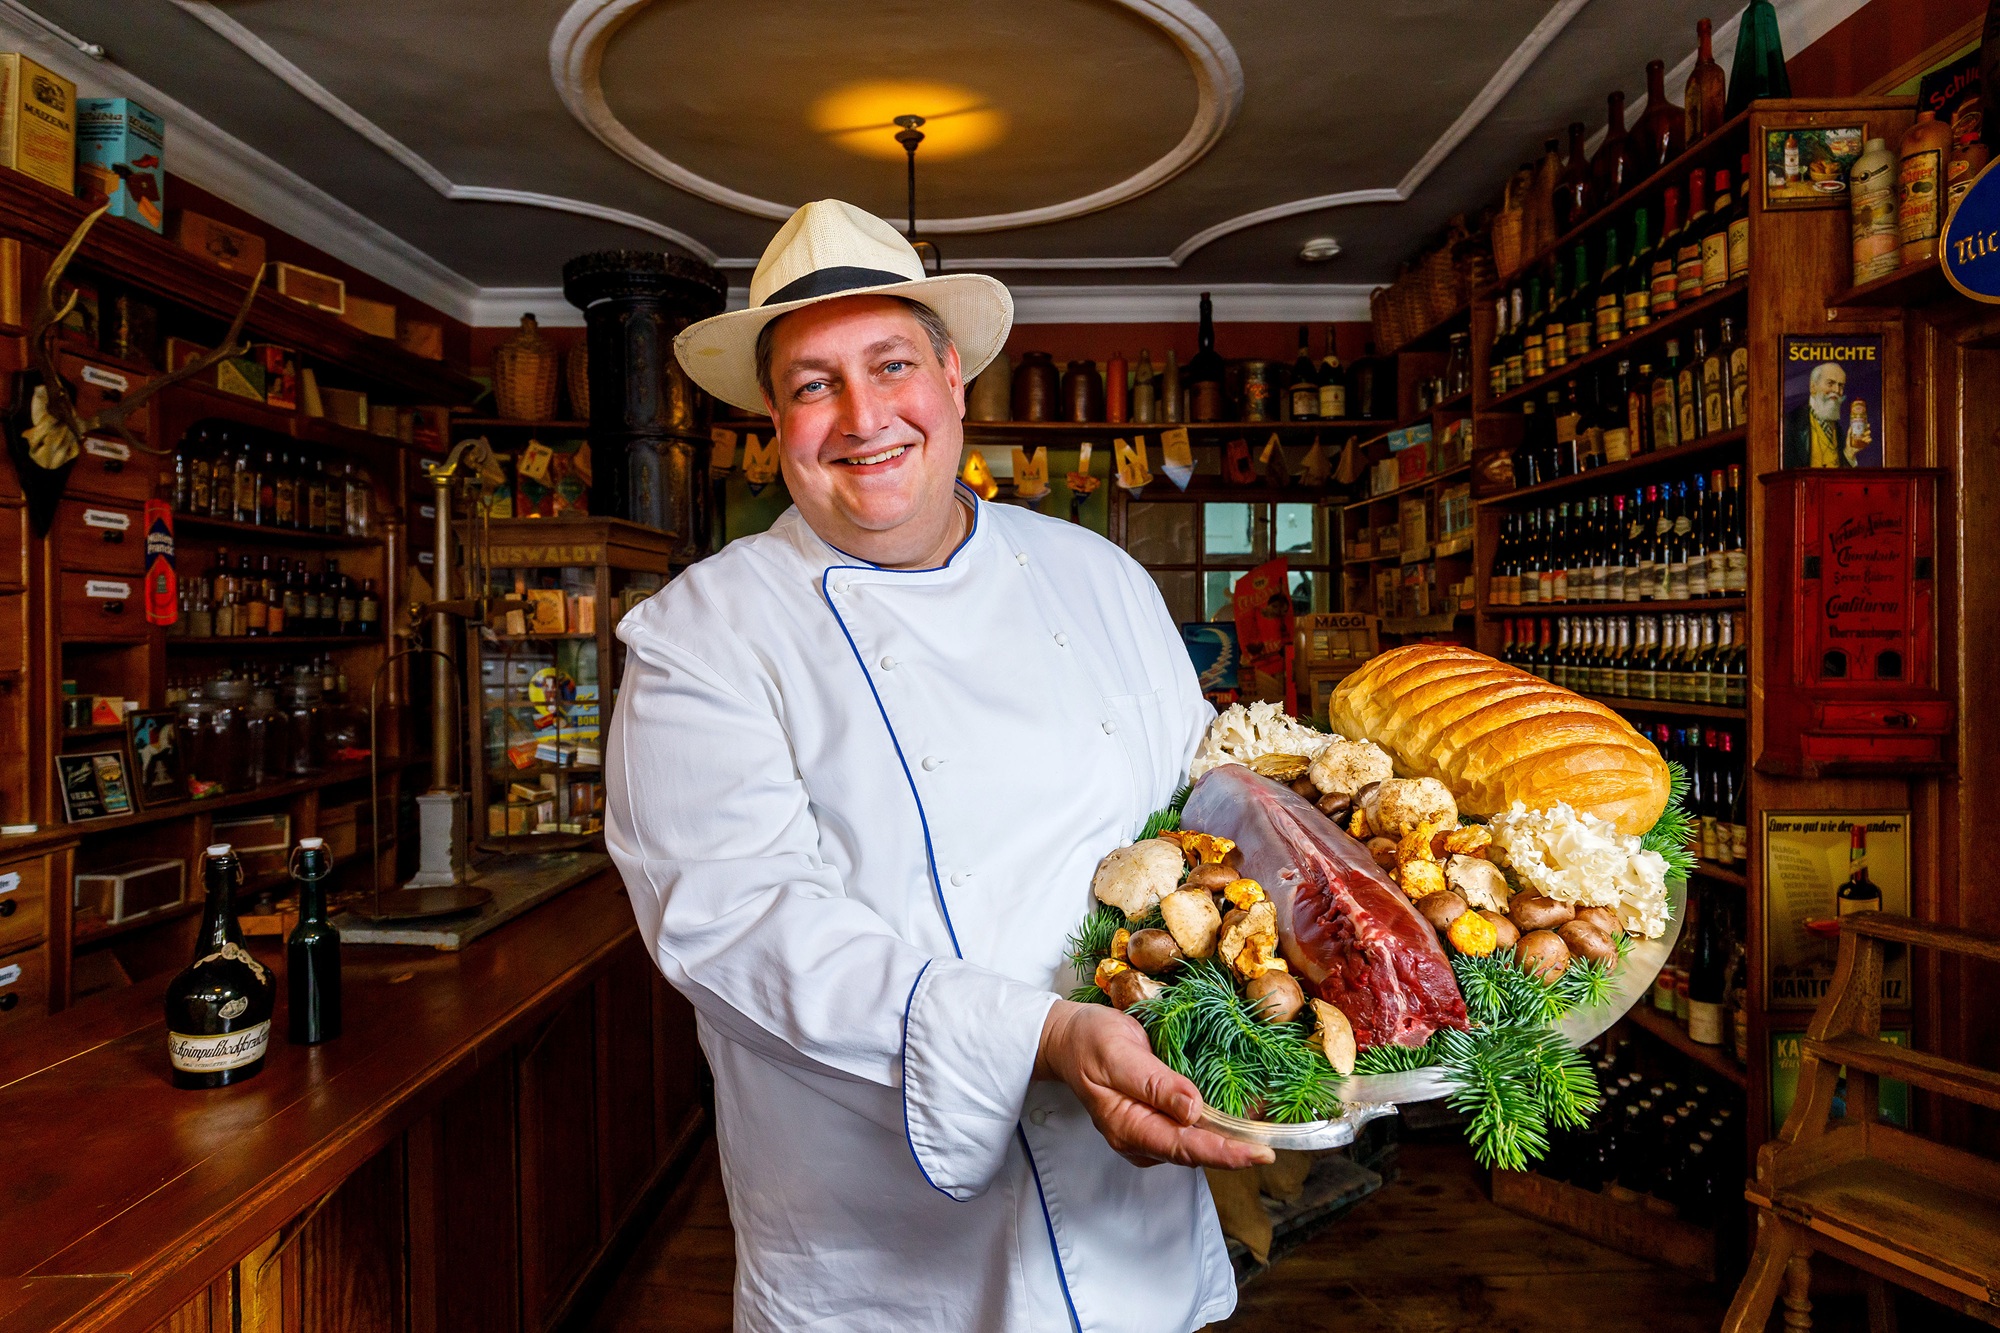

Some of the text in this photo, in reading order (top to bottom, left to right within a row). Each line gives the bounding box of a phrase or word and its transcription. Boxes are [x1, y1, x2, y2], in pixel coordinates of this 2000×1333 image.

[23, 101, 71, 132] MAIZENA
[1789, 346, 1877, 362] SCHLICHTE
[1315, 617, 1366, 628] MAGGI
[1793, 822, 1802, 832] so
[1803, 821, 1819, 834] gut
[1820, 821, 1837, 832] wie
[1866, 820, 1901, 832] andere
